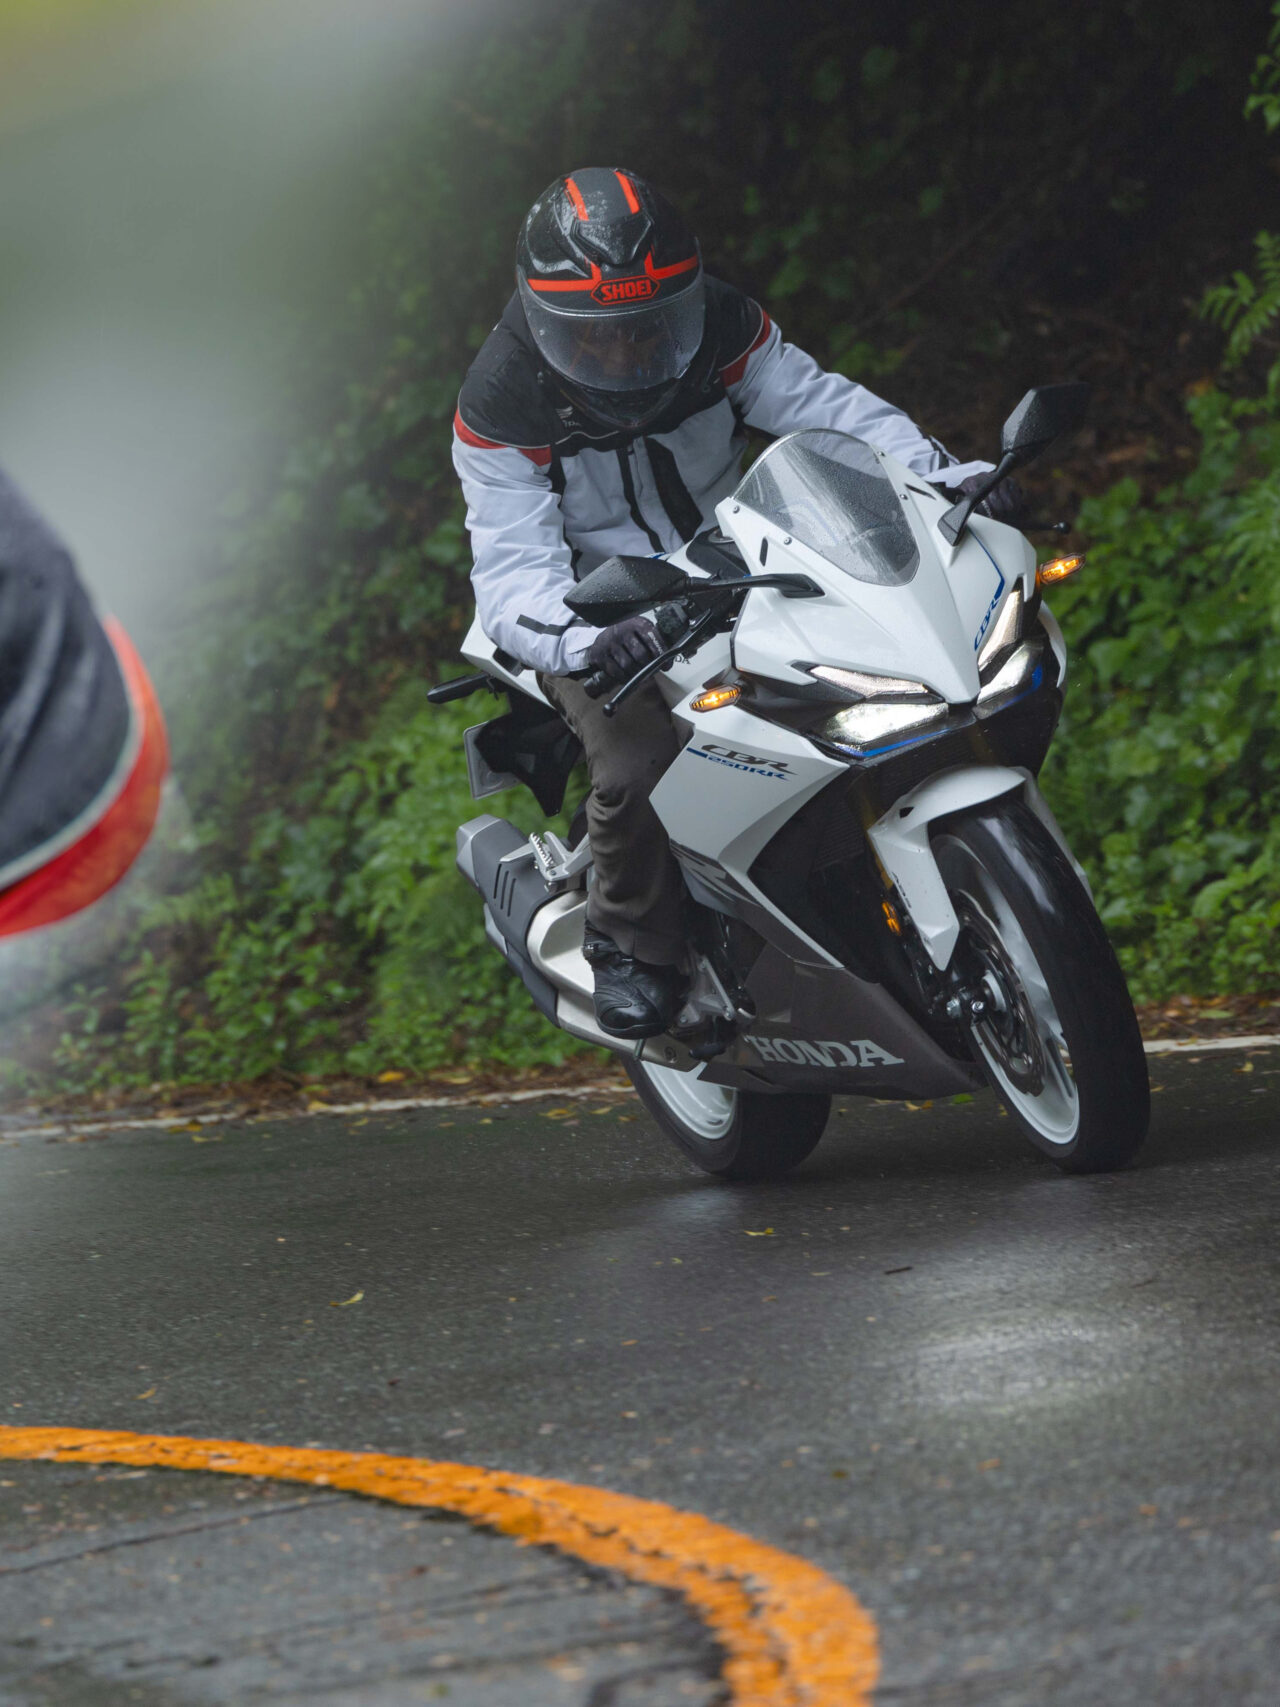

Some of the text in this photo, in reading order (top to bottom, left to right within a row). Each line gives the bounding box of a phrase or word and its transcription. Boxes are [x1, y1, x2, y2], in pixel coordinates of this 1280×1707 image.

[600, 280, 652, 301] SHOEI
[701, 744, 799, 776] CBR
[744, 1035, 905, 1068] HONDA
